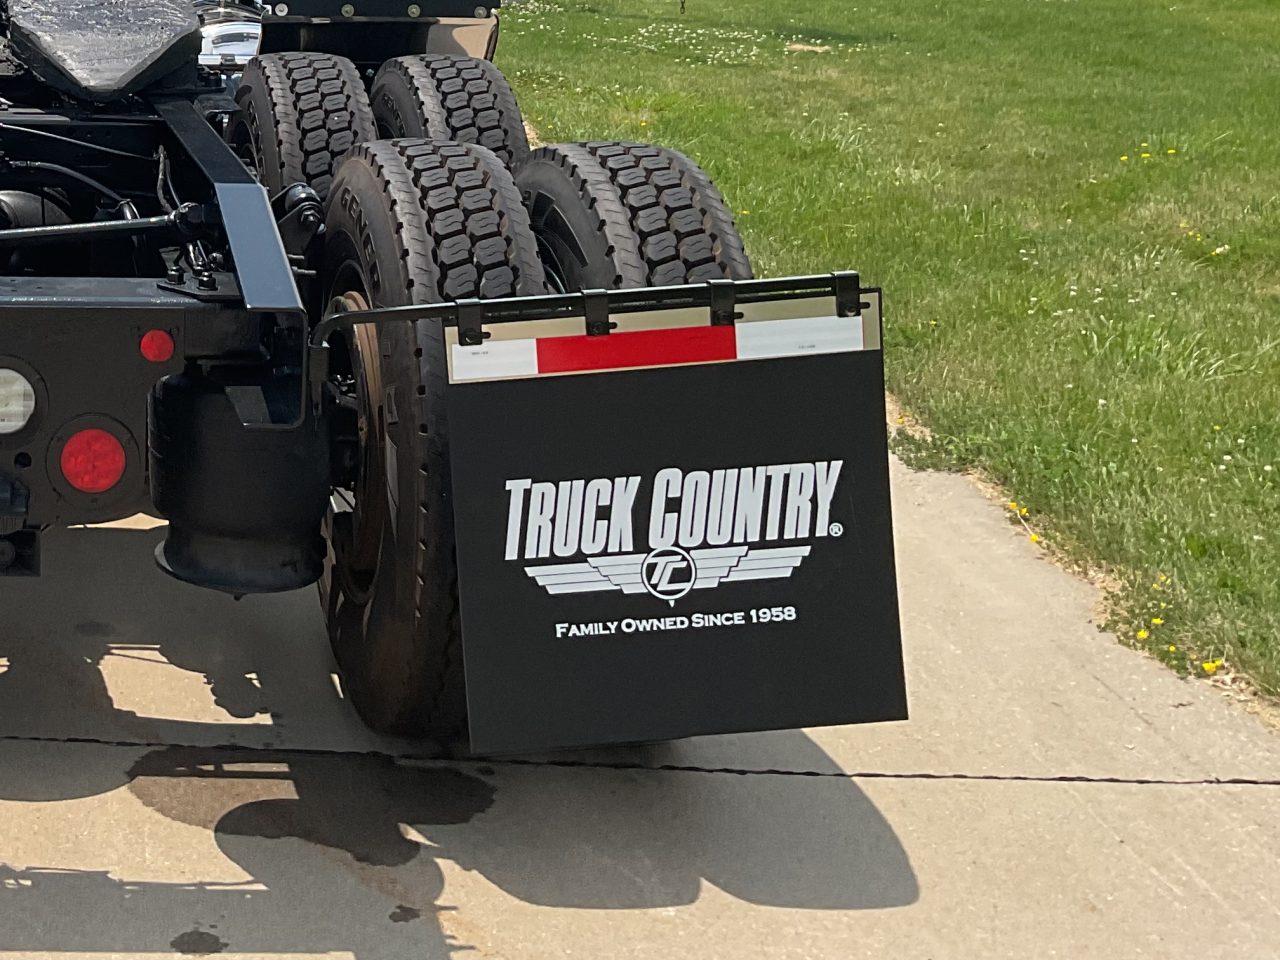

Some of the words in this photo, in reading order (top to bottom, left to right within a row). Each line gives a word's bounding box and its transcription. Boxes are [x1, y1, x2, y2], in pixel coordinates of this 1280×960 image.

[340, 186, 383, 298] GENER
[505, 475, 642, 561] TRUCK
[555, 621, 618, 638] FAMILY
[621, 616, 689, 633] OWNED
[691, 611, 745, 628] SINCE
[749, 606, 797, 623] 1958
